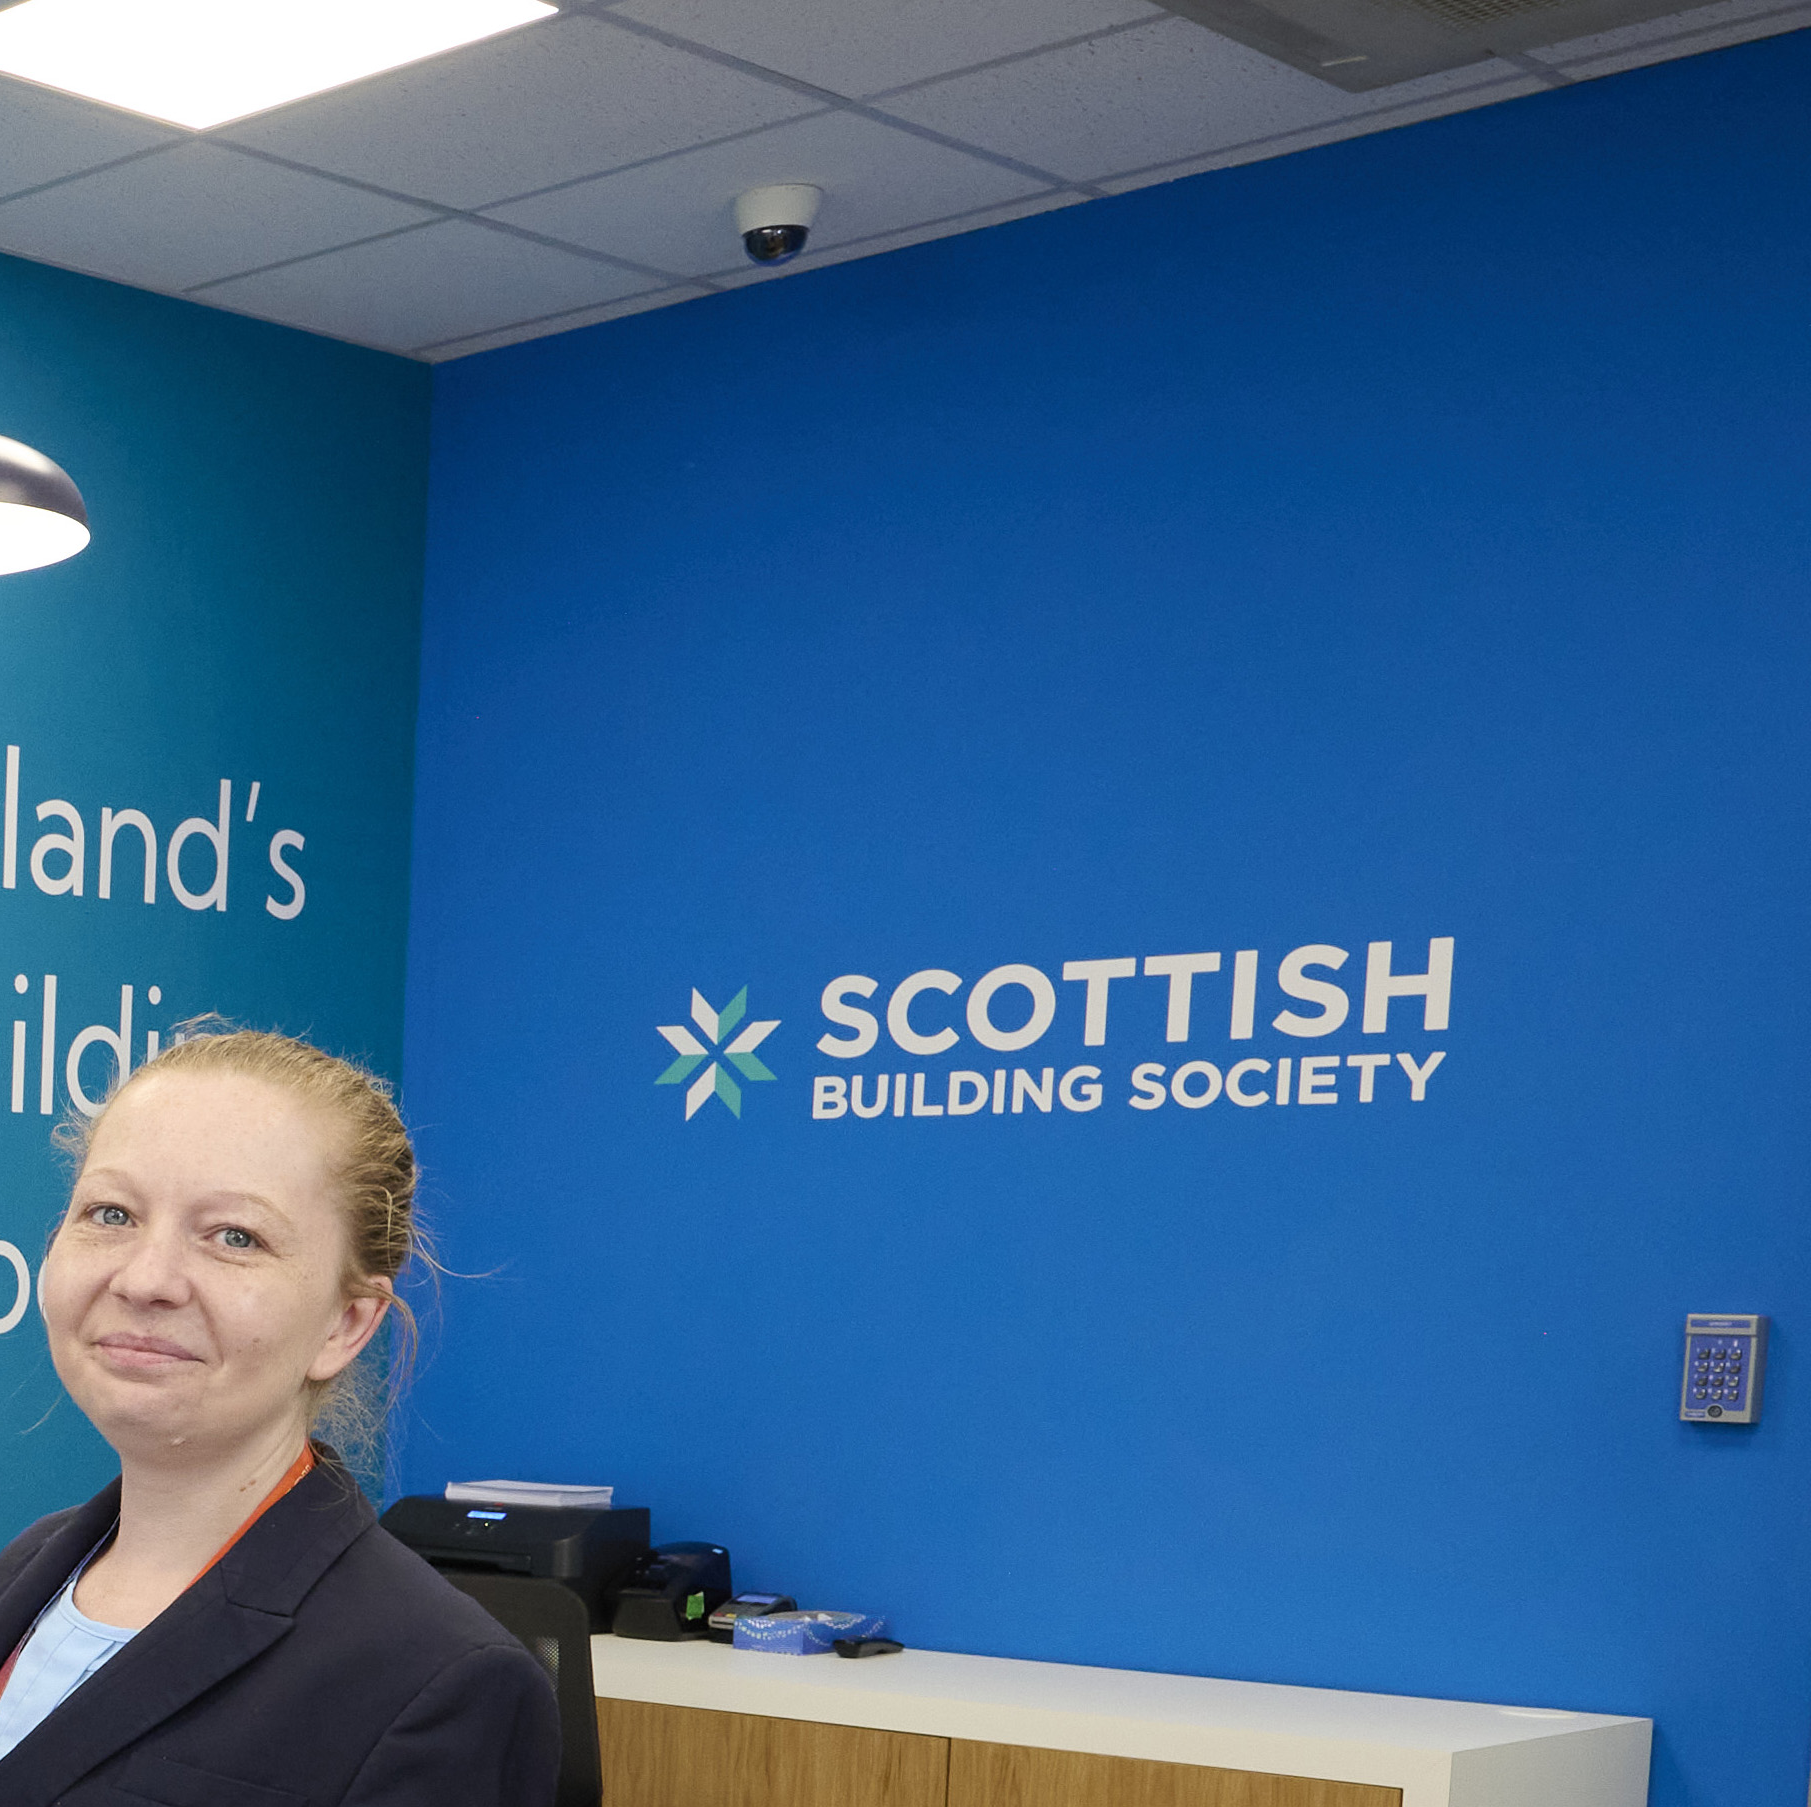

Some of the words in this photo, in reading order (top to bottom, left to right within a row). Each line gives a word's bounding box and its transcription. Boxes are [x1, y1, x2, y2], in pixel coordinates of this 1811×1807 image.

[816, 936, 1455, 1059] SCOTTISH
[812, 1065, 1103, 1119] BUILDING
[1128, 1051, 1447, 1111] SOCIETY
